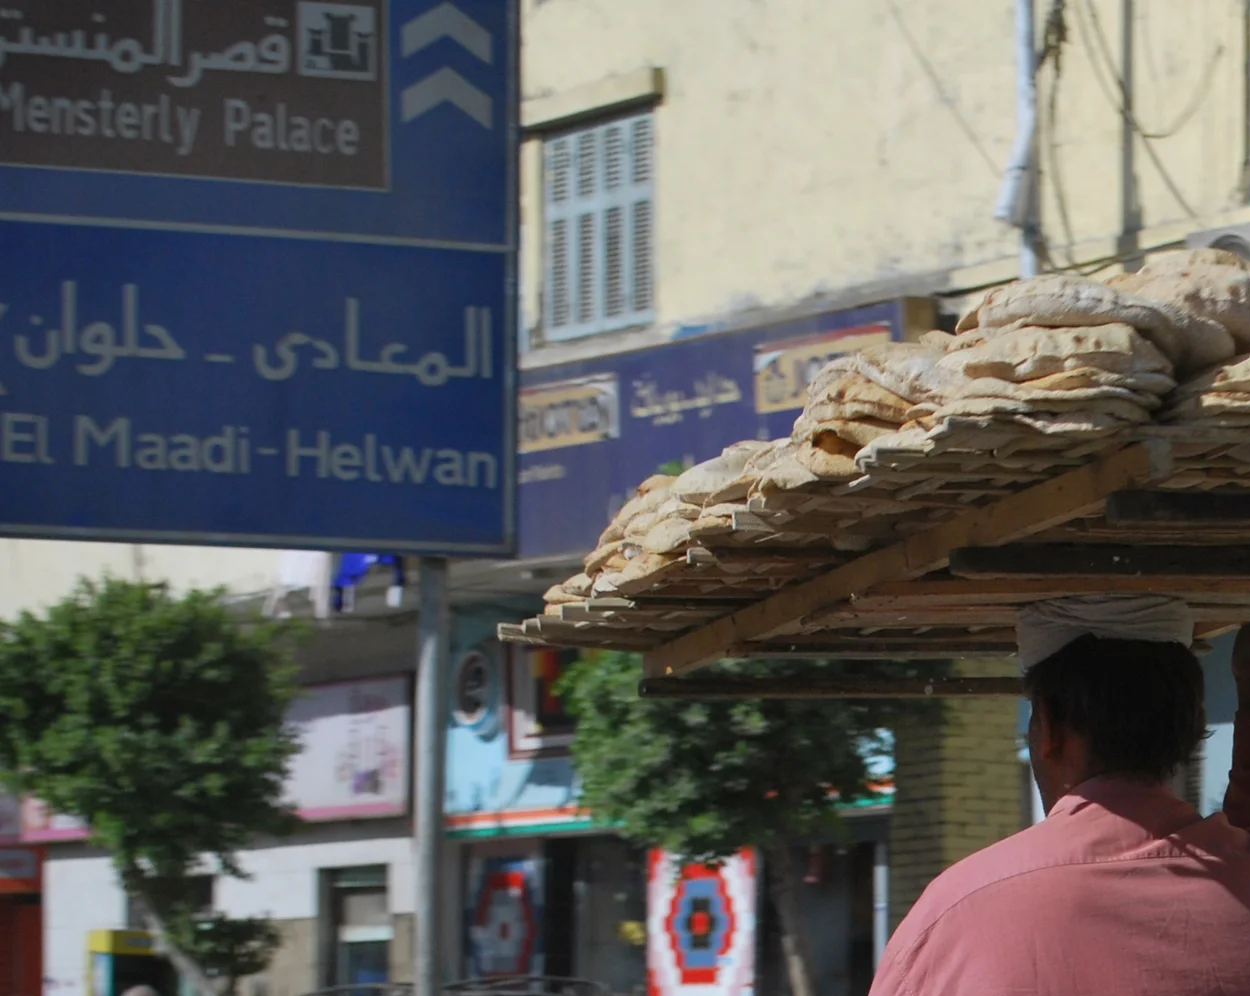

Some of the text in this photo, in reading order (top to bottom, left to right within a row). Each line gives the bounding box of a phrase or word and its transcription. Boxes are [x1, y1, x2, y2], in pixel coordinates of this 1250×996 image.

[167, 15, 291, 88] قصر
[223, 98, 360, 155] Palace
[14, 280, 187, 376] حلوان
[253, 297, 493, 386] المعادى
[1, 412, 55, 466] El
